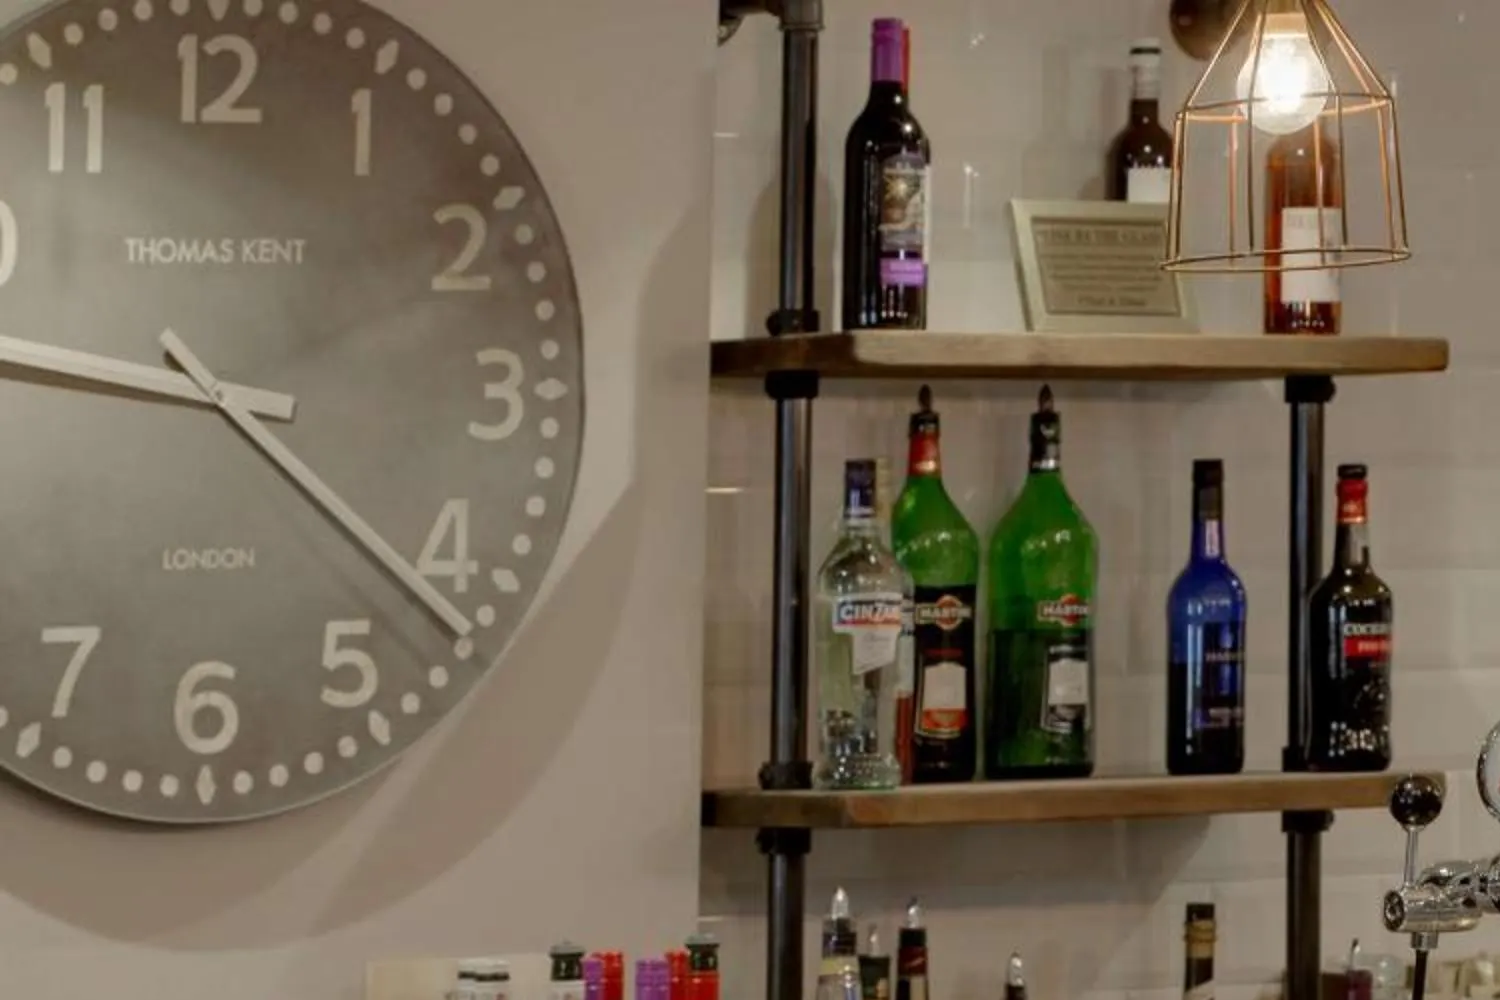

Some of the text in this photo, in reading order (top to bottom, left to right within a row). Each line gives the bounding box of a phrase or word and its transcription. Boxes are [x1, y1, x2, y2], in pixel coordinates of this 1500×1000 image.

[177, 33, 262, 124] 12
[44, 82, 104, 173] 11
[351, 88, 372, 176] 1
[125, 238, 306, 264] THOMAS KENT
[430, 203, 492, 291] 2
[467, 348, 525, 441] 3
[162, 548, 256, 570] LONDON
[416, 498, 479, 593] 4
[41, 626, 101, 718] 7
[174, 660, 239, 755] 6
[320, 619, 379, 708] 5
